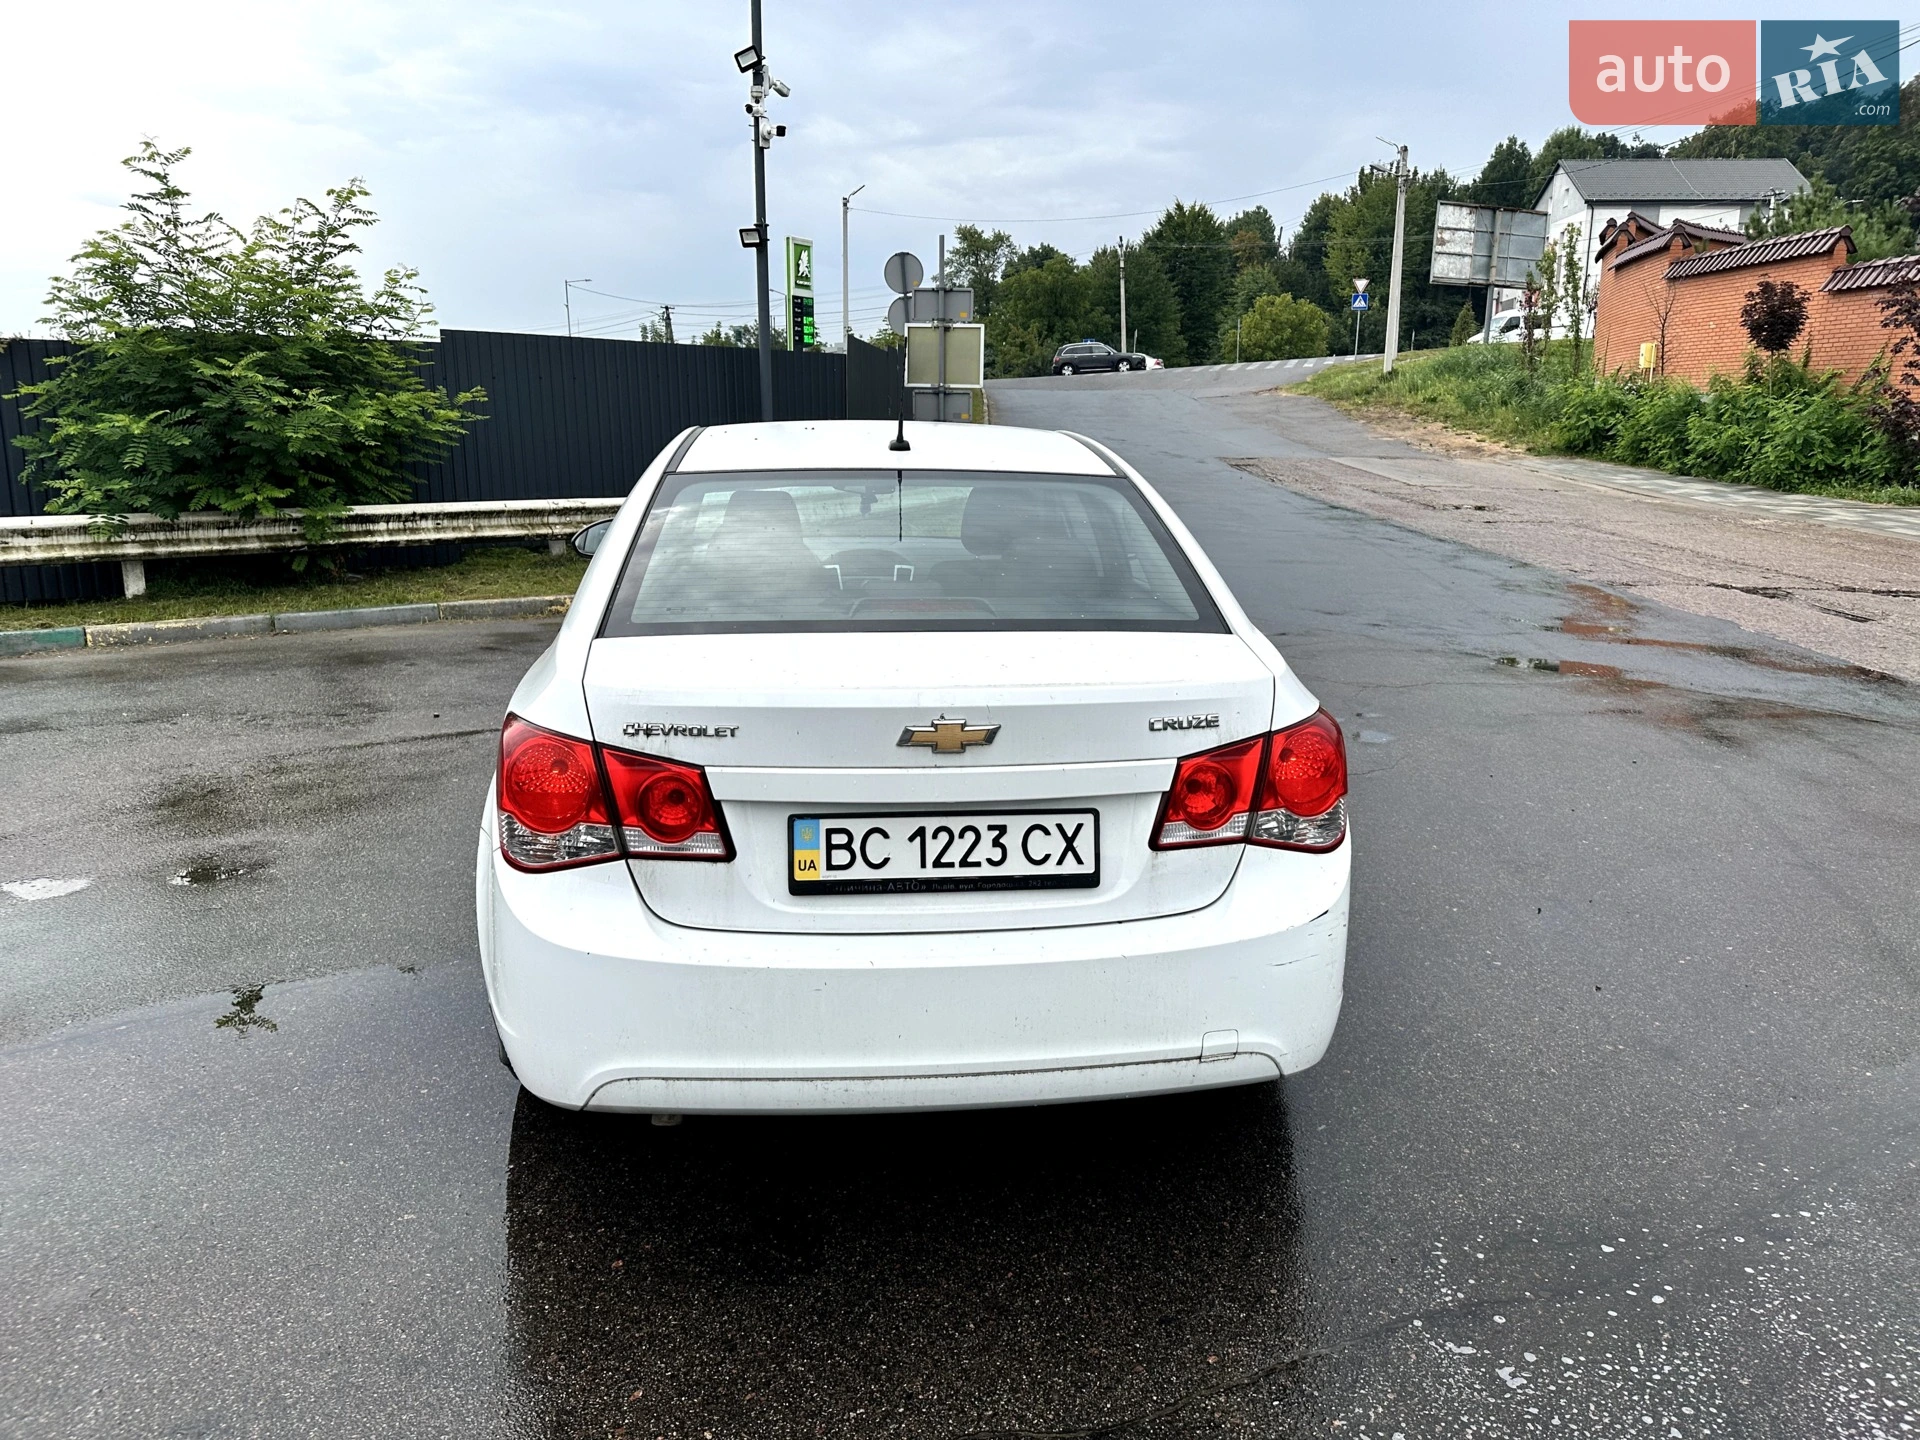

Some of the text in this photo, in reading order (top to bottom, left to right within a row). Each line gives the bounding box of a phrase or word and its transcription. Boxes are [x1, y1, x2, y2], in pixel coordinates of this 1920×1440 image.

[623, 722, 740, 738] CHEVROLET
[1149, 713, 1220, 731] CRUZE
[825, 823, 1085, 871] BC 1223 CX
[798, 859, 817, 871] UA
